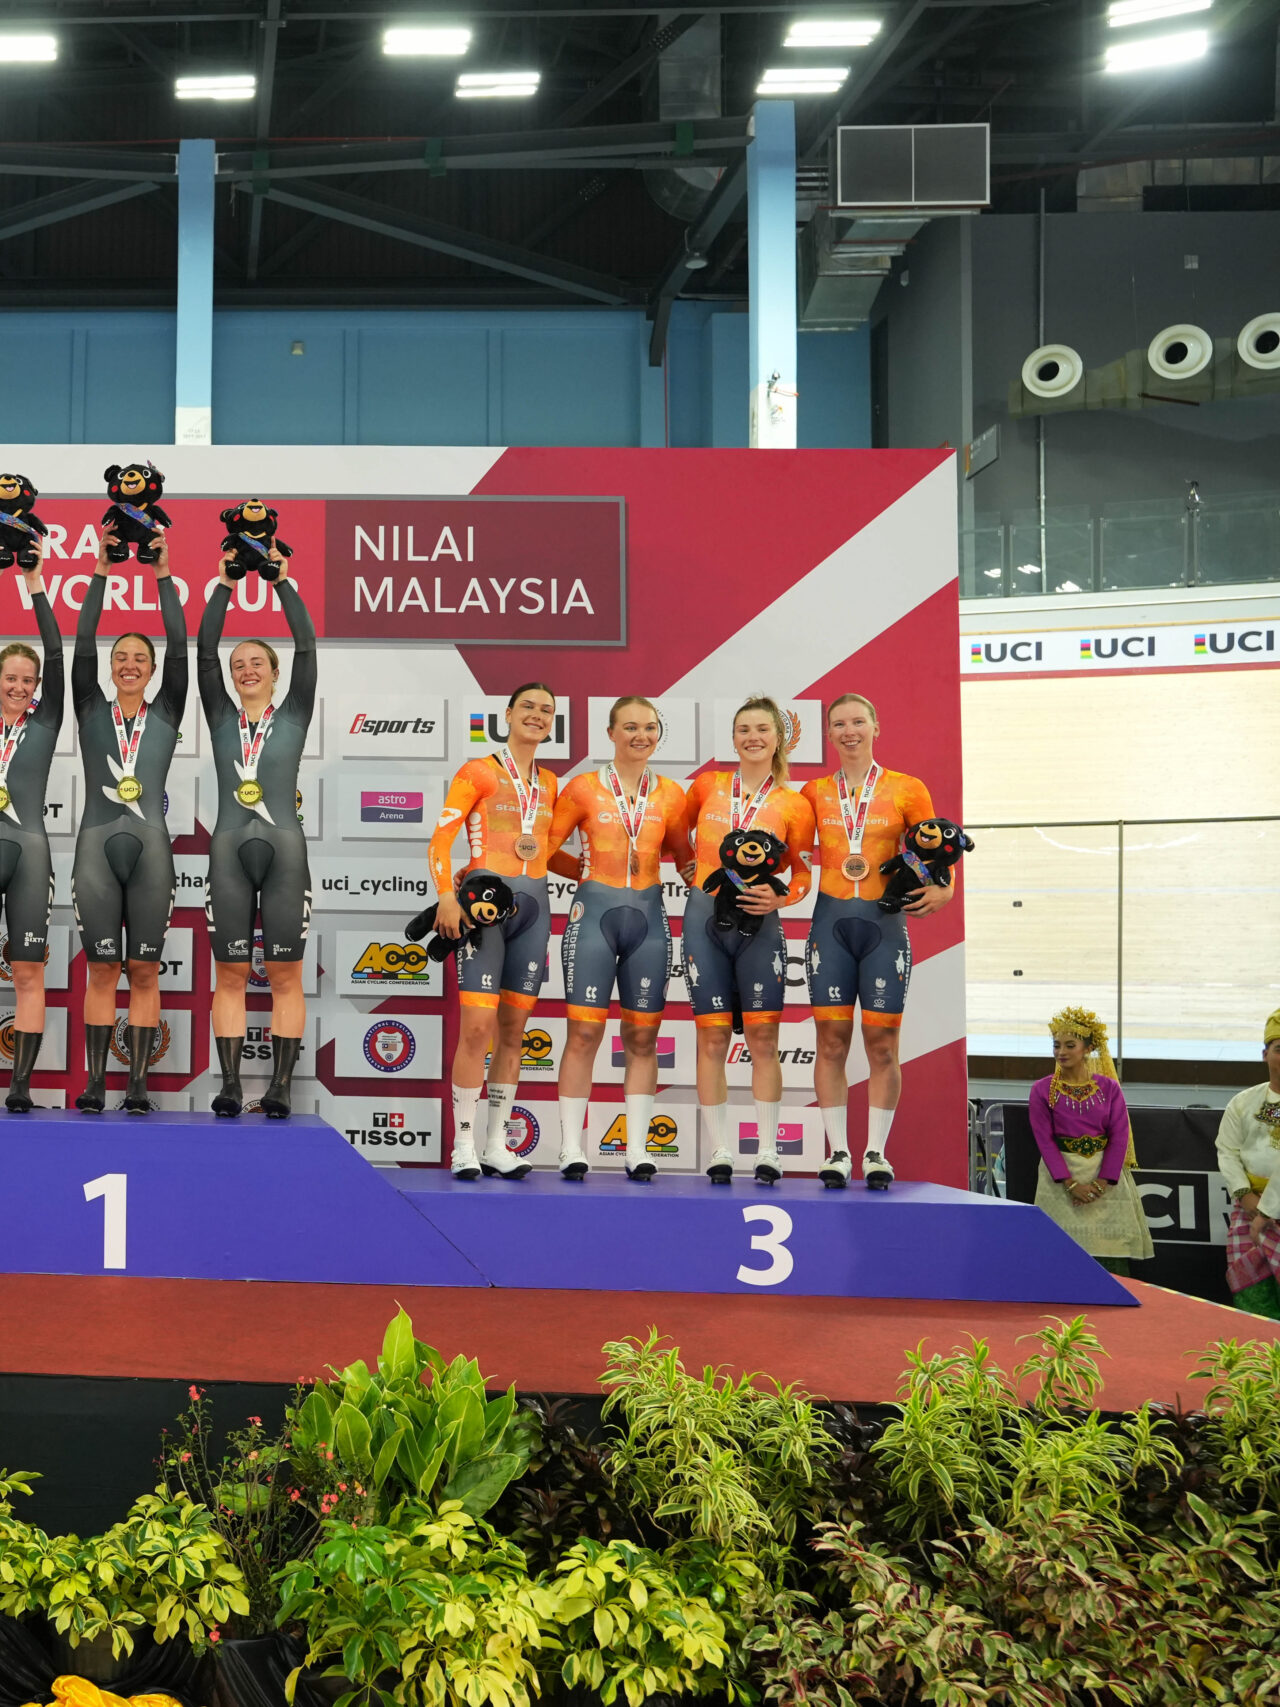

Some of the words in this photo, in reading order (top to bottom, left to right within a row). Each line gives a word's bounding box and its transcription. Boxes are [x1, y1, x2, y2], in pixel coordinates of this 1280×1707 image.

[353, 526, 475, 562] NILAI
[15, 574, 190, 611] WORLD
[354, 575, 595, 615] MALAYSIA
[984, 641, 1043, 662] UCI
[1094, 636, 1156, 659] UCI
[1209, 630, 1275, 653] UCI
[349, 713, 435, 736] isports
[488, 713, 565, 743] UI
[378, 794, 407, 804] astro
[379, 812, 404, 820] Arena
[322, 875, 428, 896] uci_cycling
[567, 923, 581, 994] NEDERLANDSE
[727, 1043, 815, 1065] isrts
[346, 1129, 431, 1147] TISSOT
[1144, 1182, 1196, 1230] CI
[83, 1174, 127, 1269] 1
[736, 1205, 794, 1286] 3
